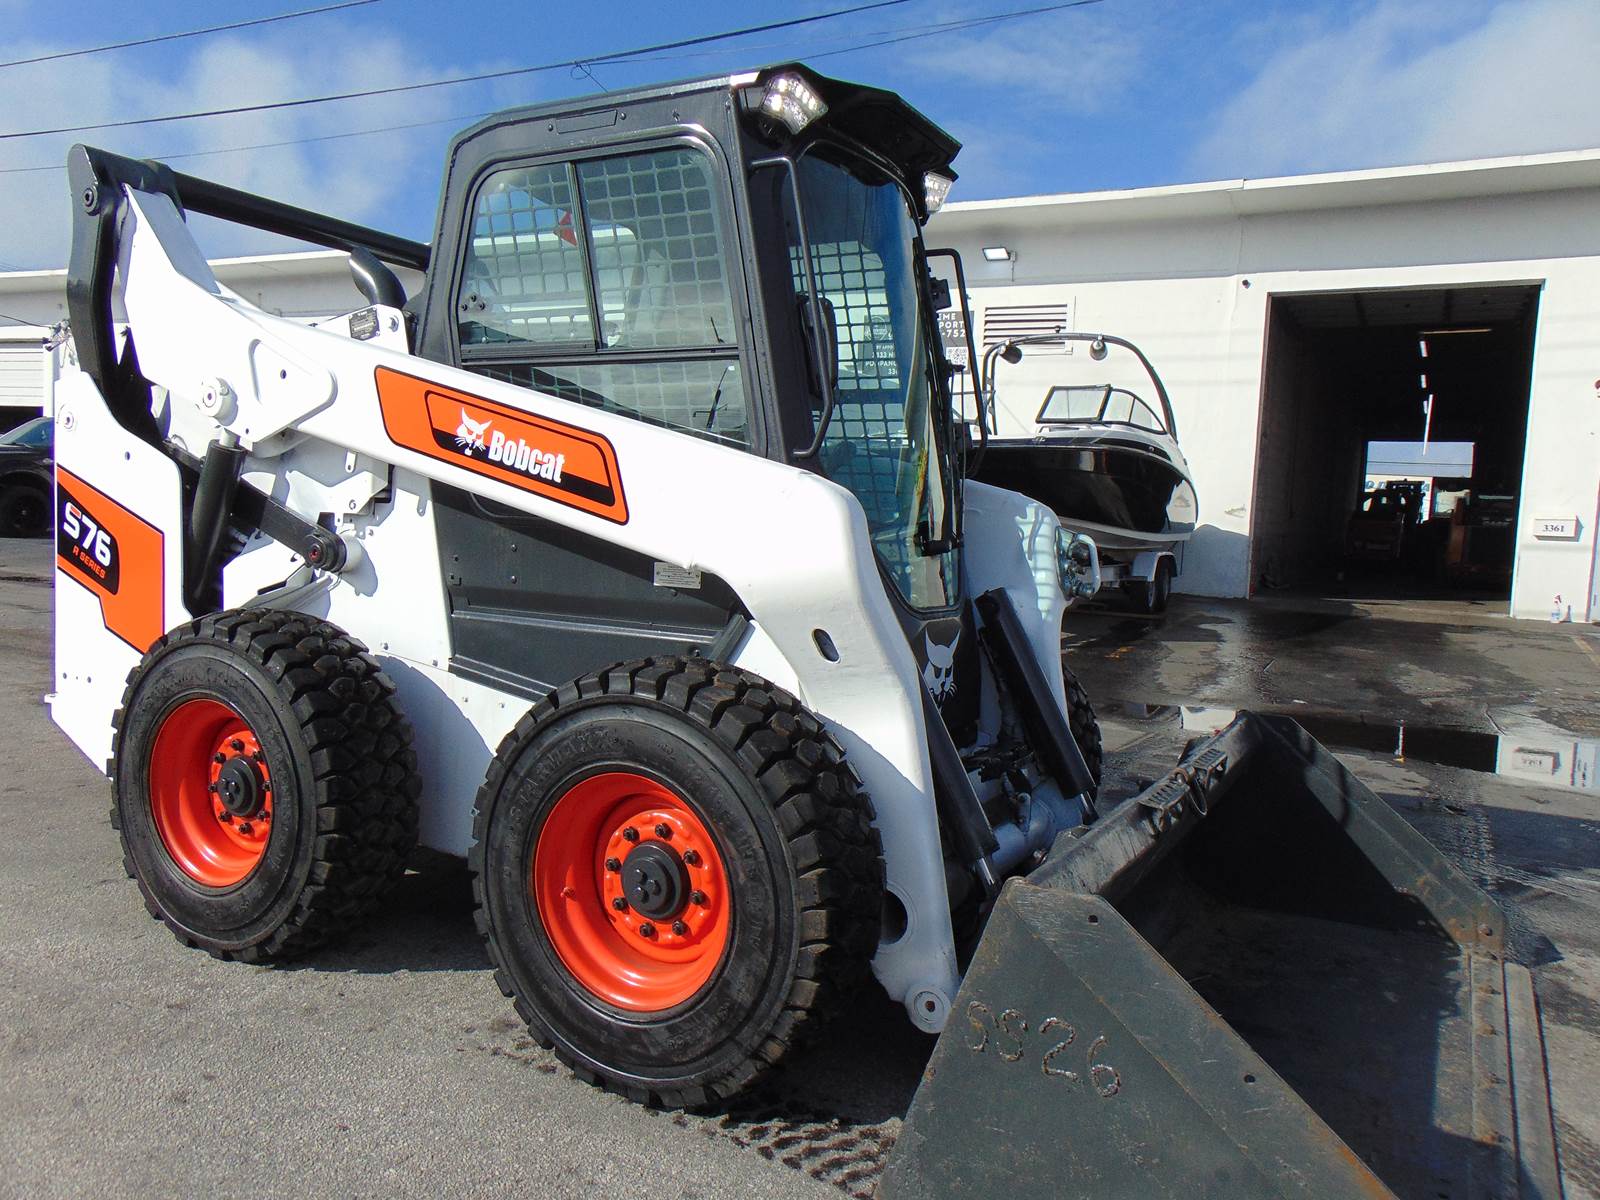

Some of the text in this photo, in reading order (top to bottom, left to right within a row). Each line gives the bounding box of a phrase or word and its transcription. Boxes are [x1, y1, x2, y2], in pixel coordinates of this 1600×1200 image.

[487, 430, 566, 483] Bobcat
[63, 502, 111, 567] S76
[1542, 524, 1565, 532] 3361
[72, 546, 106, 579] R SERIES
